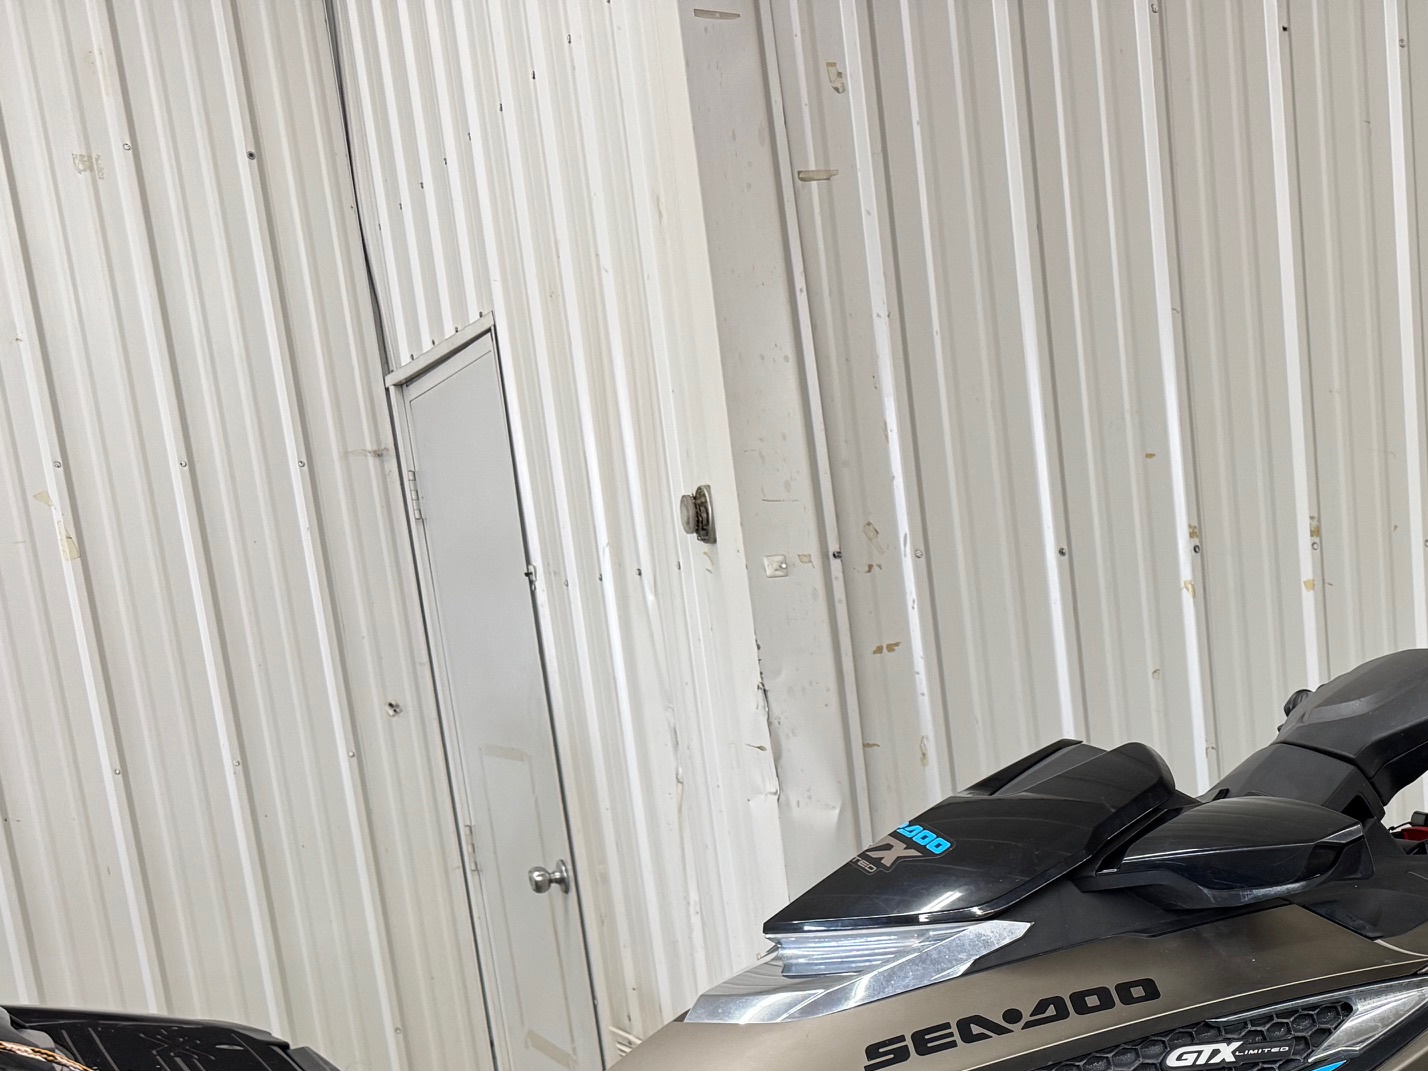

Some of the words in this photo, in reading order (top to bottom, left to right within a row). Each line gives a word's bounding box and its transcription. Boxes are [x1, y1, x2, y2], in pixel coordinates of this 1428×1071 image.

[865, 835, 923, 867] TX
[1165, 1041, 1243, 1067] GTX
[1236, 1046, 1289, 1056] LIMITED
